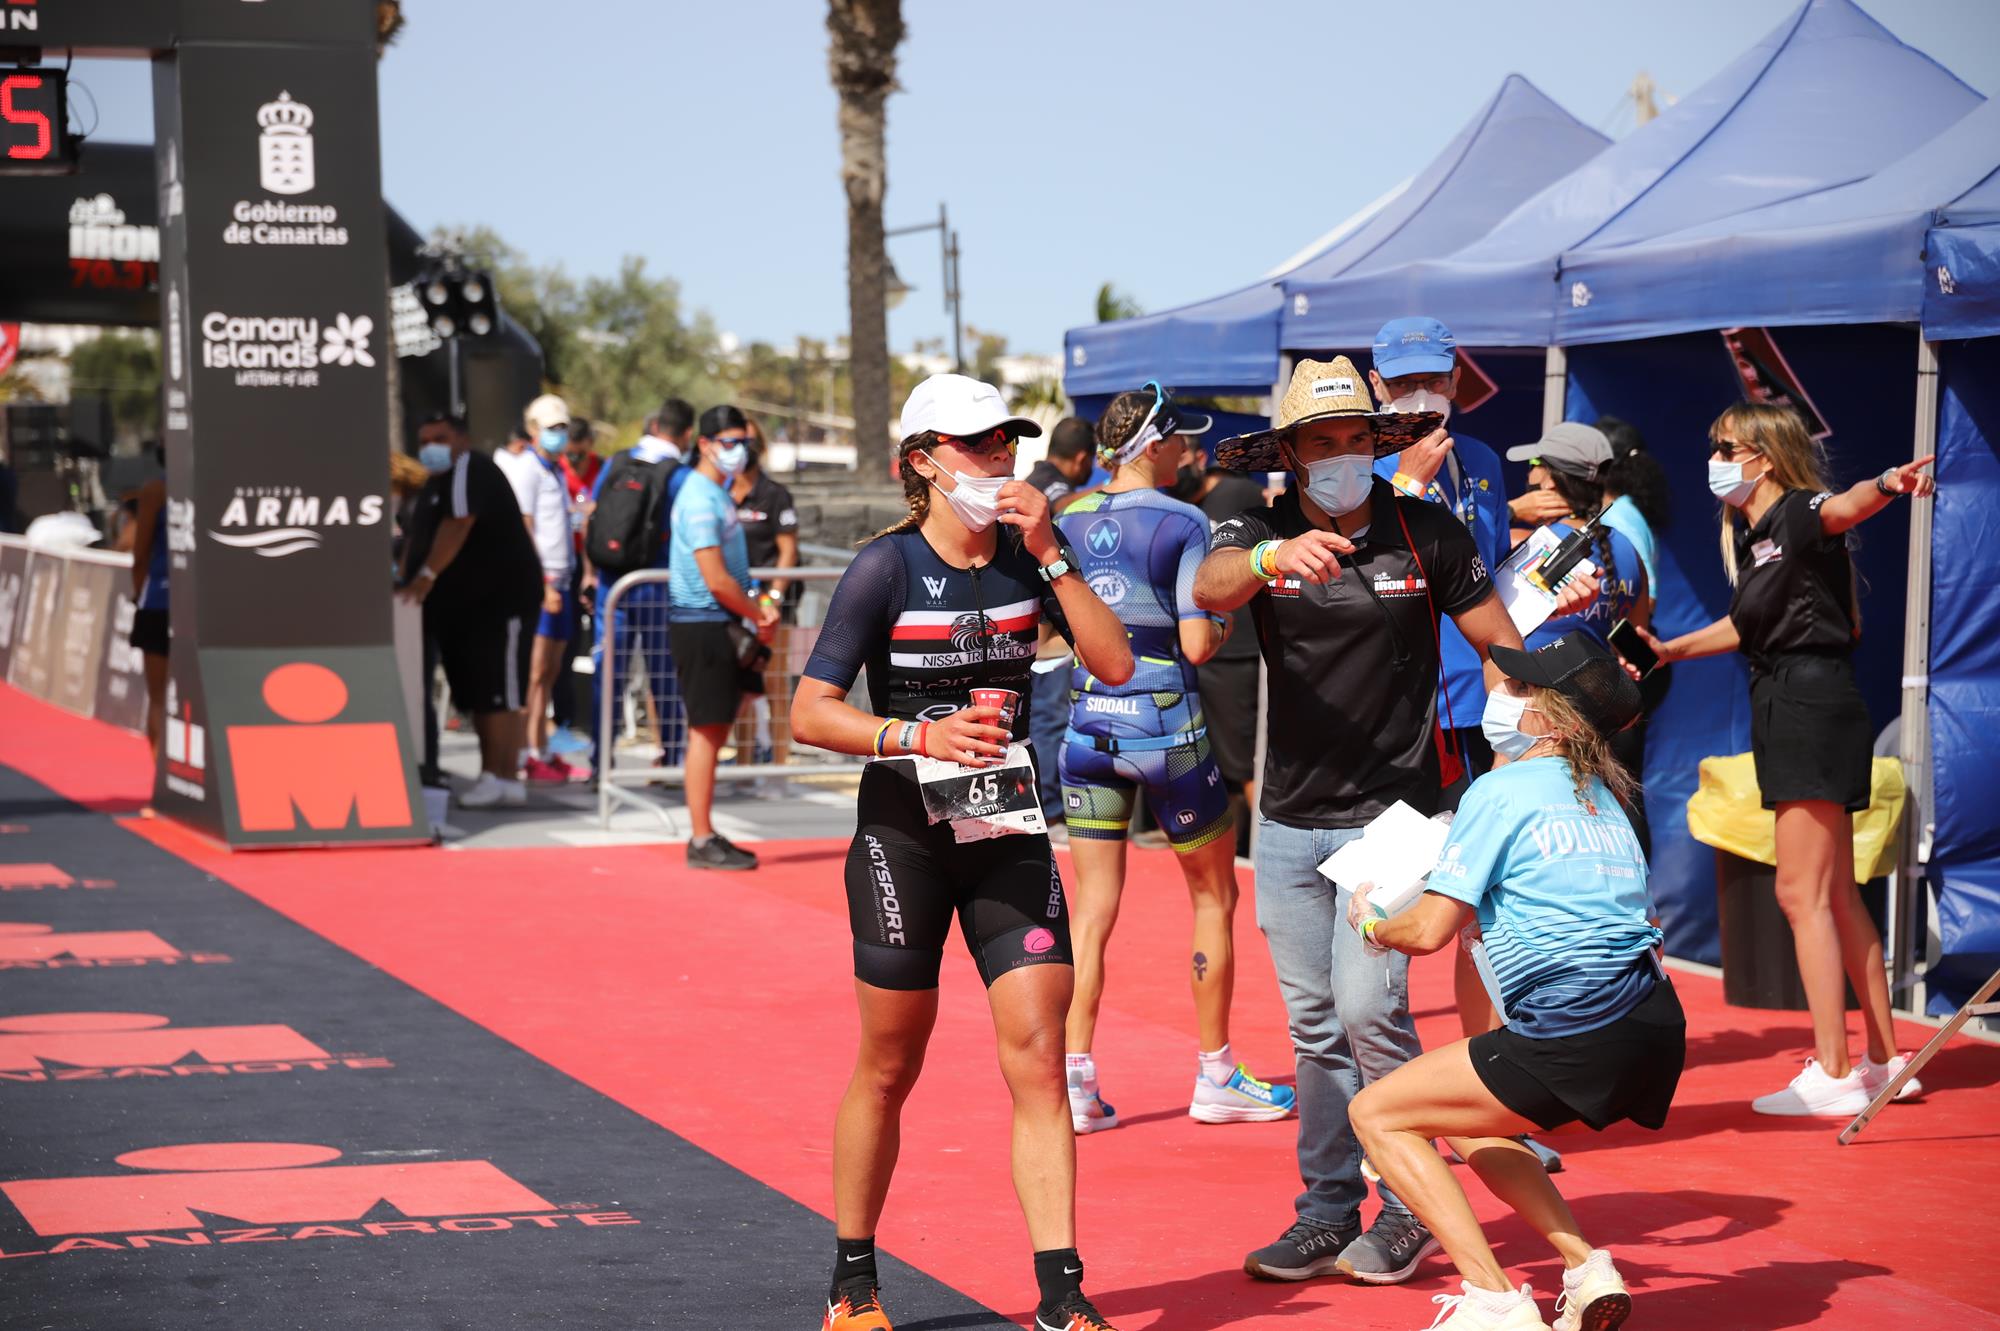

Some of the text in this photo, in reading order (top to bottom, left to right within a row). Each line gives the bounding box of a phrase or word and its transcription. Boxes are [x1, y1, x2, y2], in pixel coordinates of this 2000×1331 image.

[233, 201, 337, 223] Gobierno
[224, 224, 348, 246] de Canarias
[202, 312, 318, 348] Canary
[203, 340, 319, 368] Islands
[221, 494, 384, 527] ARMAS
[922, 644, 1032, 667] NISSA TRIATHLON
[1086, 697, 1140, 715] SIDDALL
[968, 774, 999, 804] 65
[965, 802, 1006, 817] JUSTINE
[1011, 959, 1021, 967] Le
[1023, 954, 1047, 963] Point
[1239, 1080, 1273, 1102] HOKA
